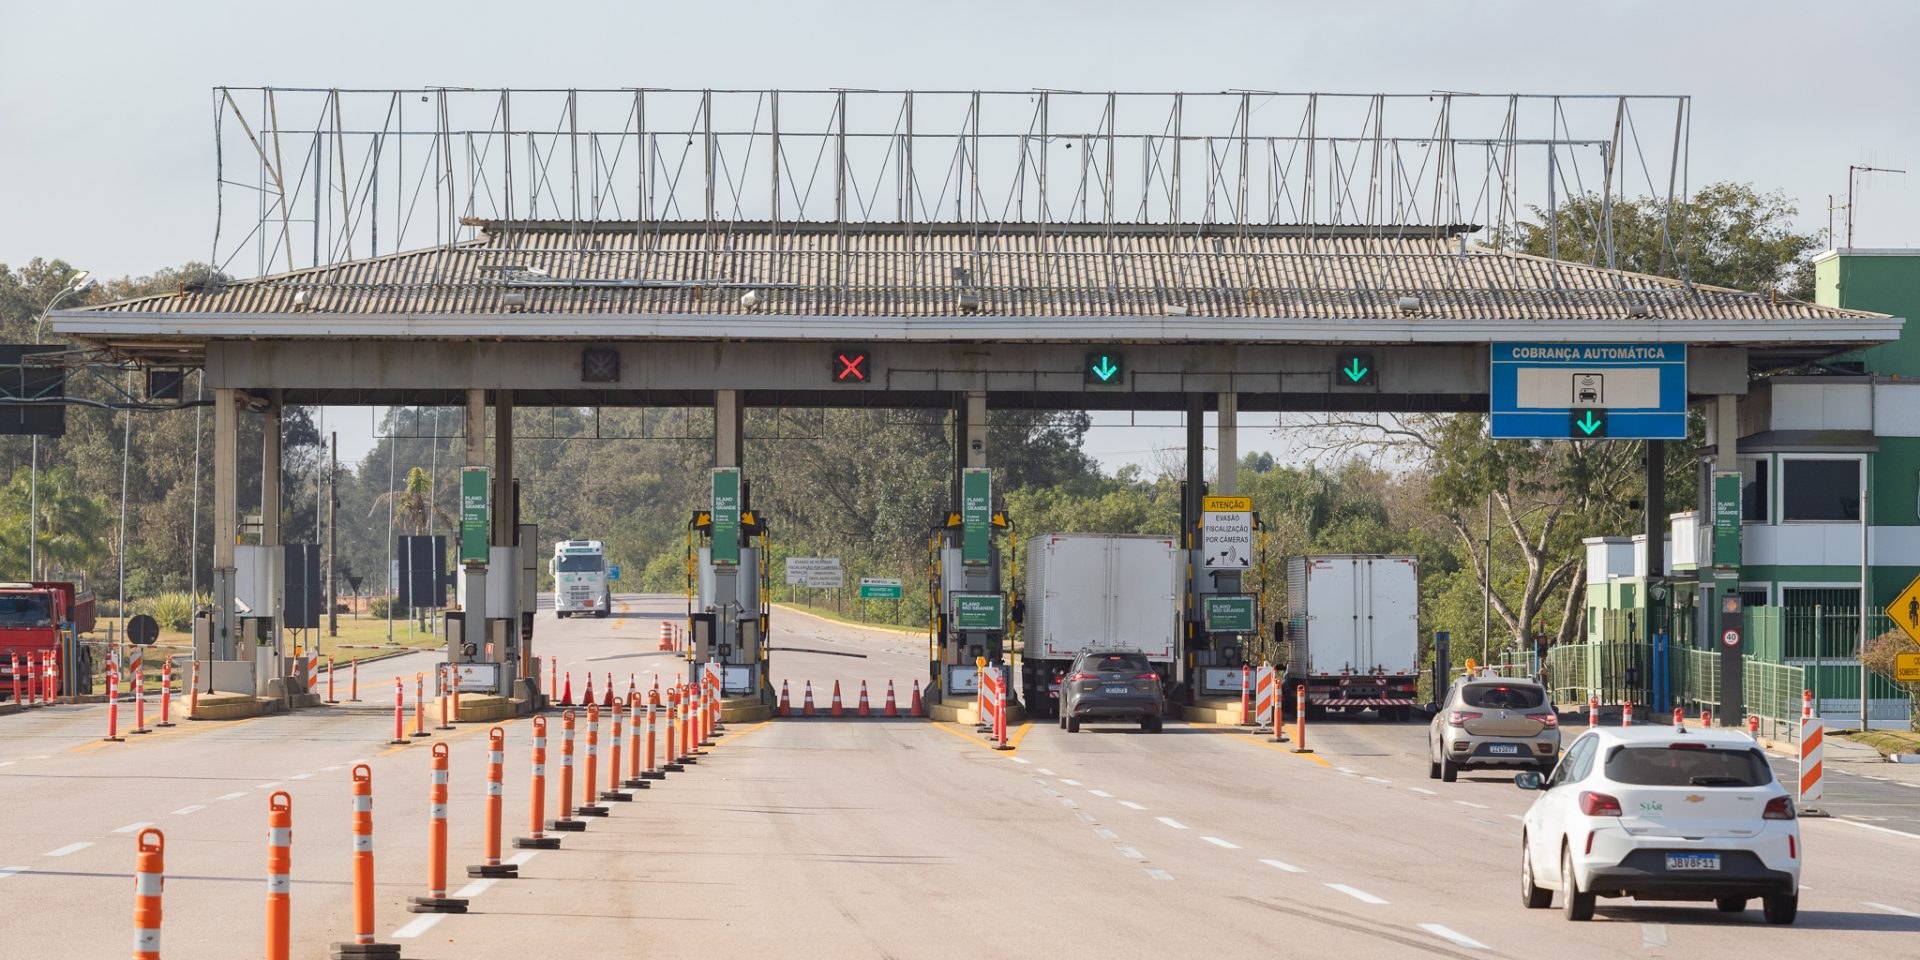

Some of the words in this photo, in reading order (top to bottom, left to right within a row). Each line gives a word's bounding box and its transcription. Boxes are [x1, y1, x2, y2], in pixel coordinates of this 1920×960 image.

[1512, 347, 1580, 361] COBRANÇA
[1583, 346, 1665, 359] AUTOMÁTICA
[1211, 500, 1244, 509] ATENÇÃO
[1215, 514, 1240, 522] EVASÃO
[1206, 525, 1249, 533] FISCALIZAÇÃO
[1219, 535, 1249, 543] CÂMERAS
[1899, 667, 1919, 676] SOMENTE
[1640, 802, 1663, 811] STAR
[1671, 858, 1715, 868] JBV8F11
